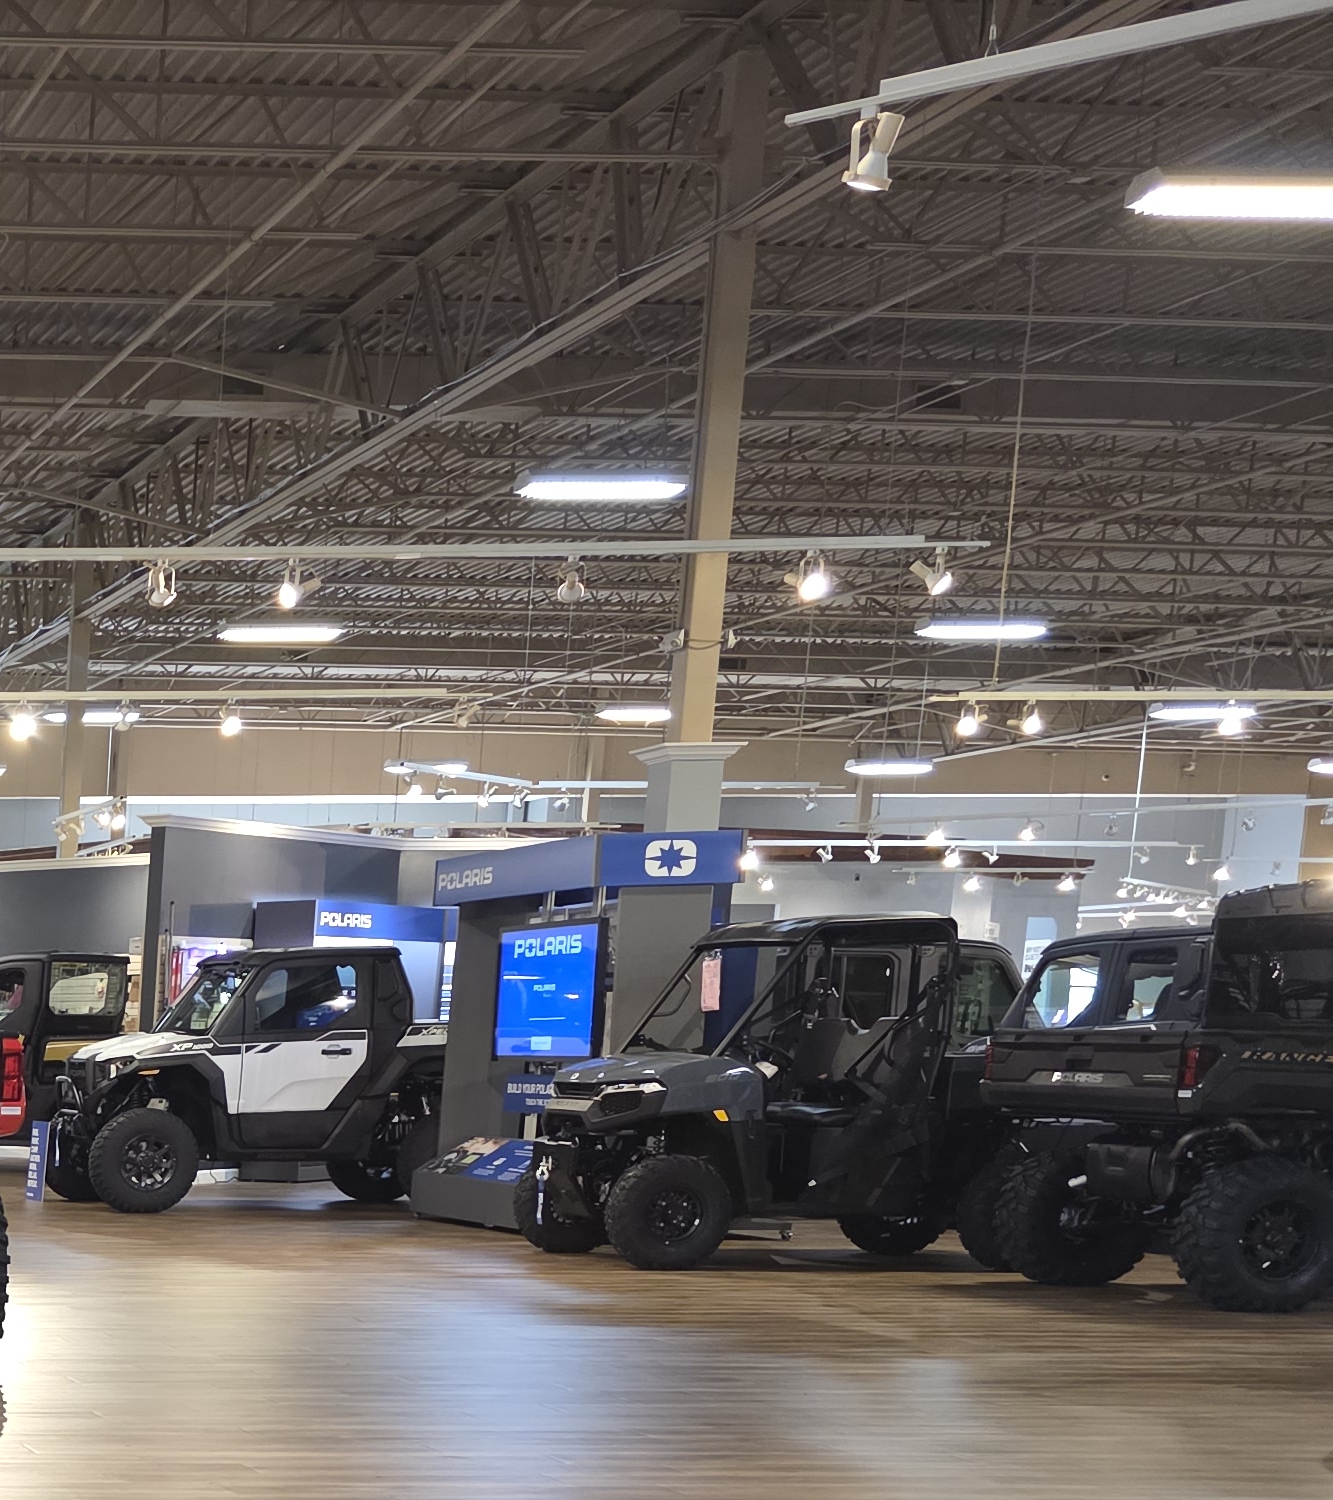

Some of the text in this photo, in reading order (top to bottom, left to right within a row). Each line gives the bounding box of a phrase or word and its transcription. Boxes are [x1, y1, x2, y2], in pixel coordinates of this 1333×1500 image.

[437, 866, 493, 891] POLARIS
[319, 911, 372, 929] POLARIS
[514, 934, 582, 959] POLARIS
[170, 1042, 193, 1052] XP
[1051, 1071, 1104, 1083] POLARIS
